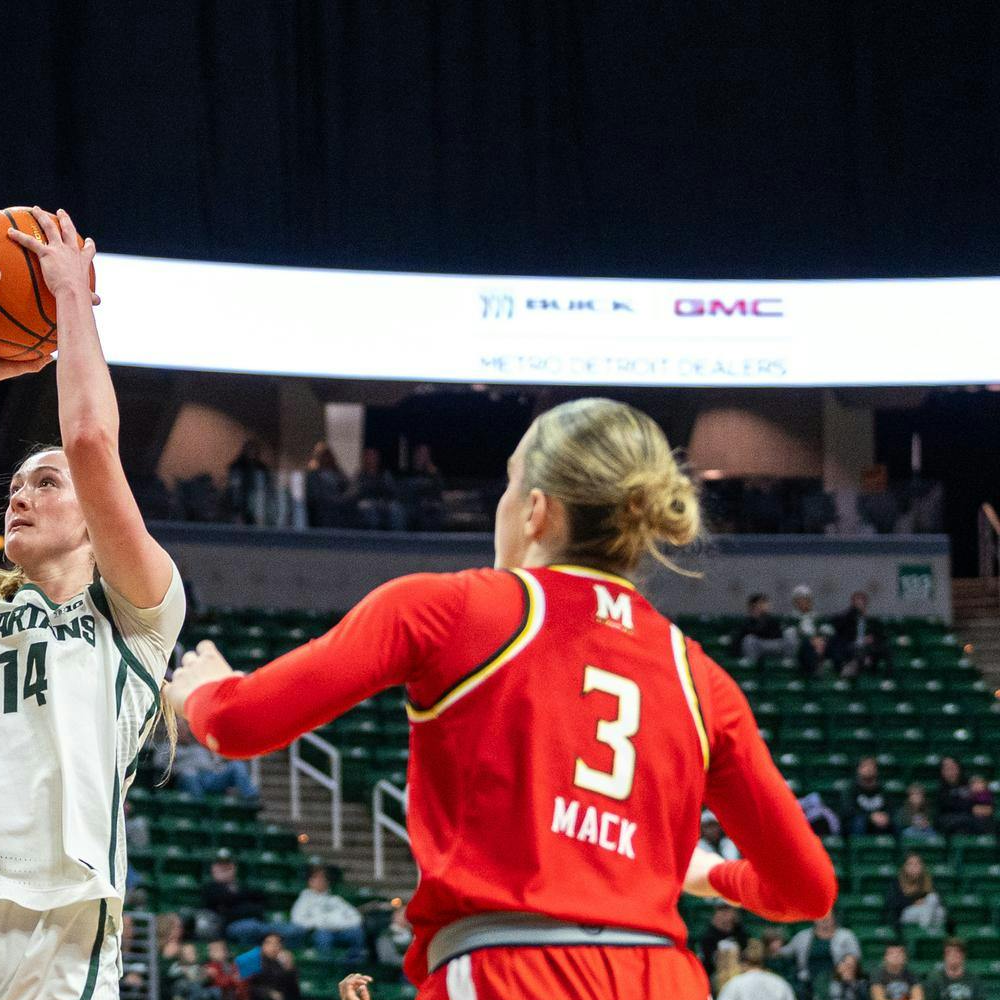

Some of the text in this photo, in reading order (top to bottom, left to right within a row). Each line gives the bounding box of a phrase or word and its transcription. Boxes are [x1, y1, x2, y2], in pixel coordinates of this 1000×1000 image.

[673, 297, 784, 318] GMC
[593, 584, 635, 630] M
[573, 664, 641, 801] 3
[551, 796, 637, 860] MACK
